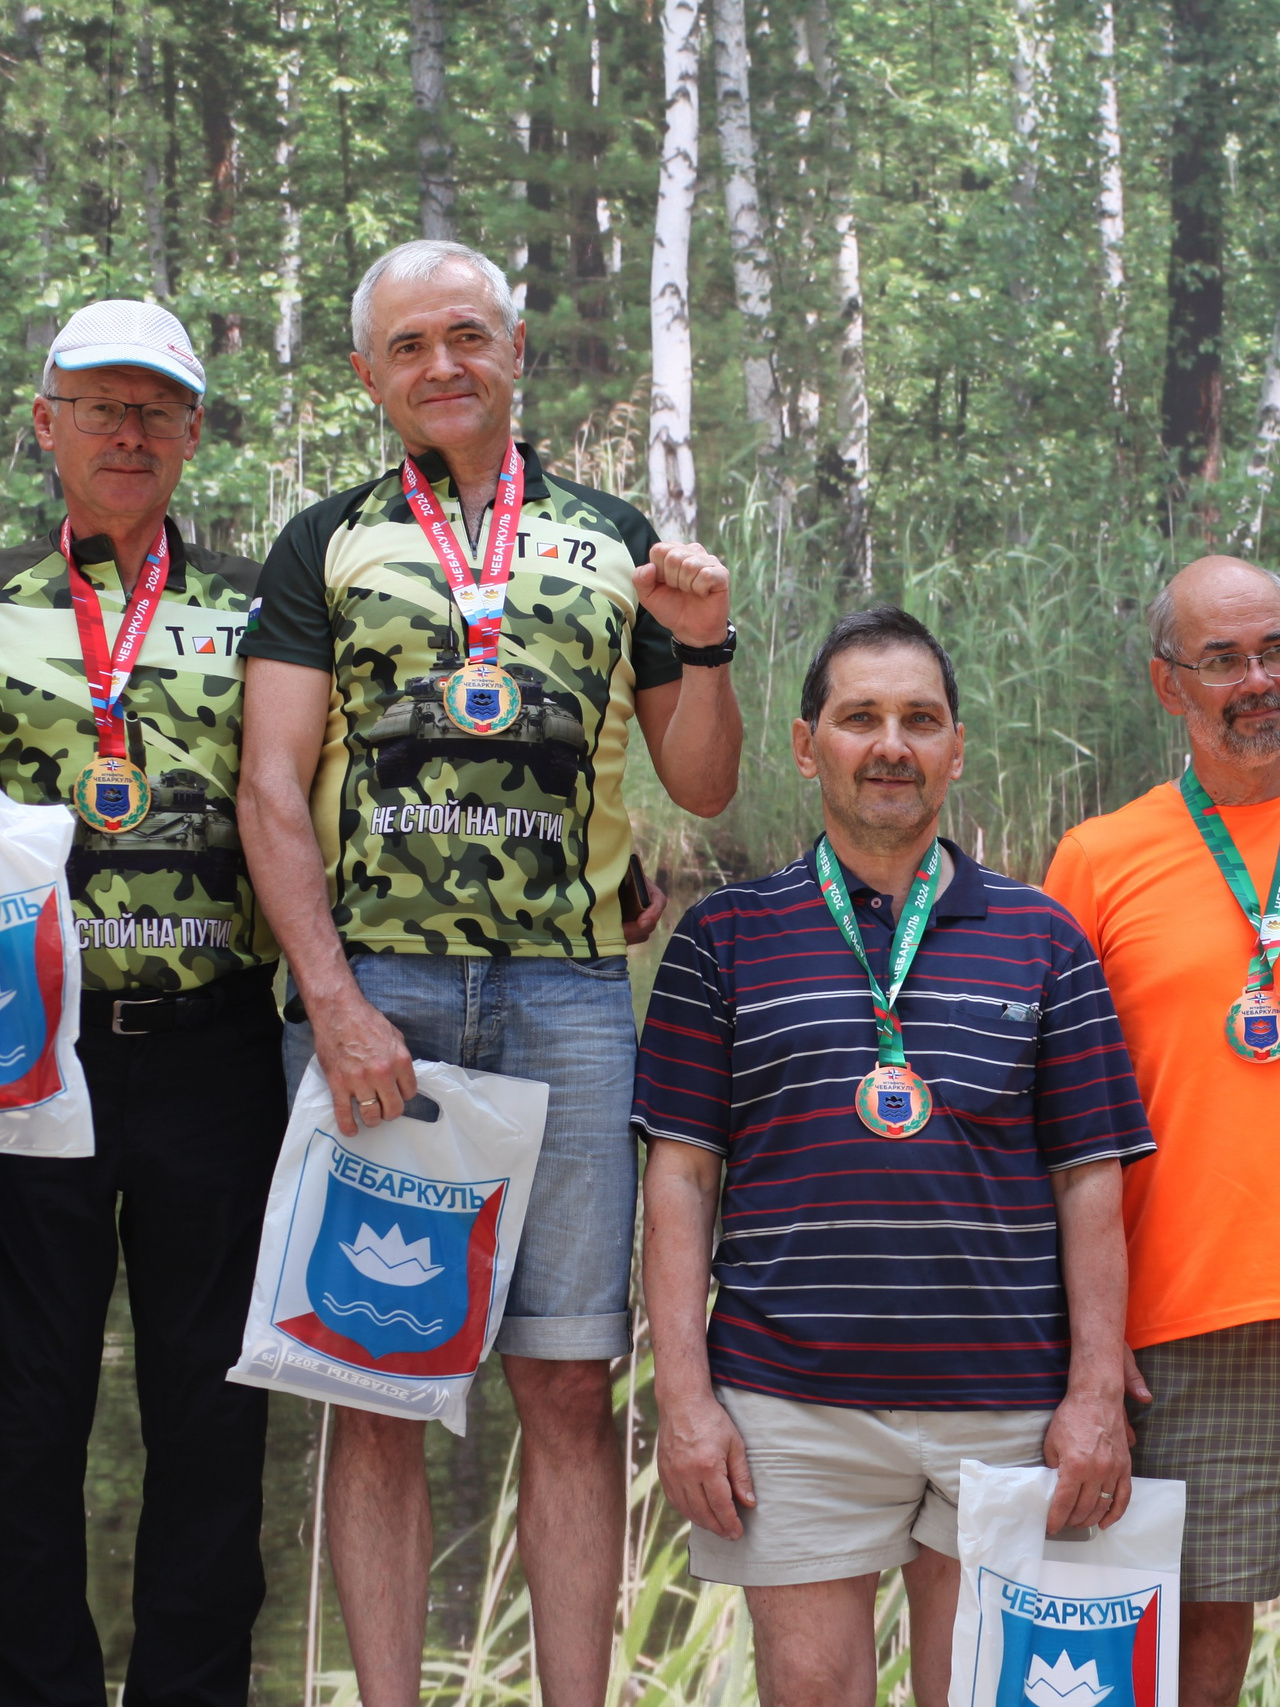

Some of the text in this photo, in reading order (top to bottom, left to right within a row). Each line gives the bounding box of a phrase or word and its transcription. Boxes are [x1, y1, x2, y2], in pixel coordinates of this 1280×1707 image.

[415, 492, 434, 517] 2024
[490, 513, 511, 576] ЧЕБАРКУЛЬ
[504, 483, 516, 506] 2024
[431, 521, 465, 583] ЧЕБАРКУЛЬ
[563, 537, 597, 573] 72
[117, 598, 150, 662] ЧЕБАРКУЛЬ
[146, 565, 162, 592] 2024
[370, 799, 564, 842] НЕ СТОЙ НА ПУТИ!
[0, 897, 43, 924] ЛЬ
[828, 883, 844, 910] 2024
[75, 912, 233, 949] СТОЙ НА ПУТИ!
[894, 914, 920, 980] ЧЕБАРКУЛЬ
[915, 883, 930, 910] 2024
[331, 1146, 485, 1210] ЧЕБАРКУЛЬ
[1001, 1584, 1145, 1625] ЧЕБАРКУЛЬ
